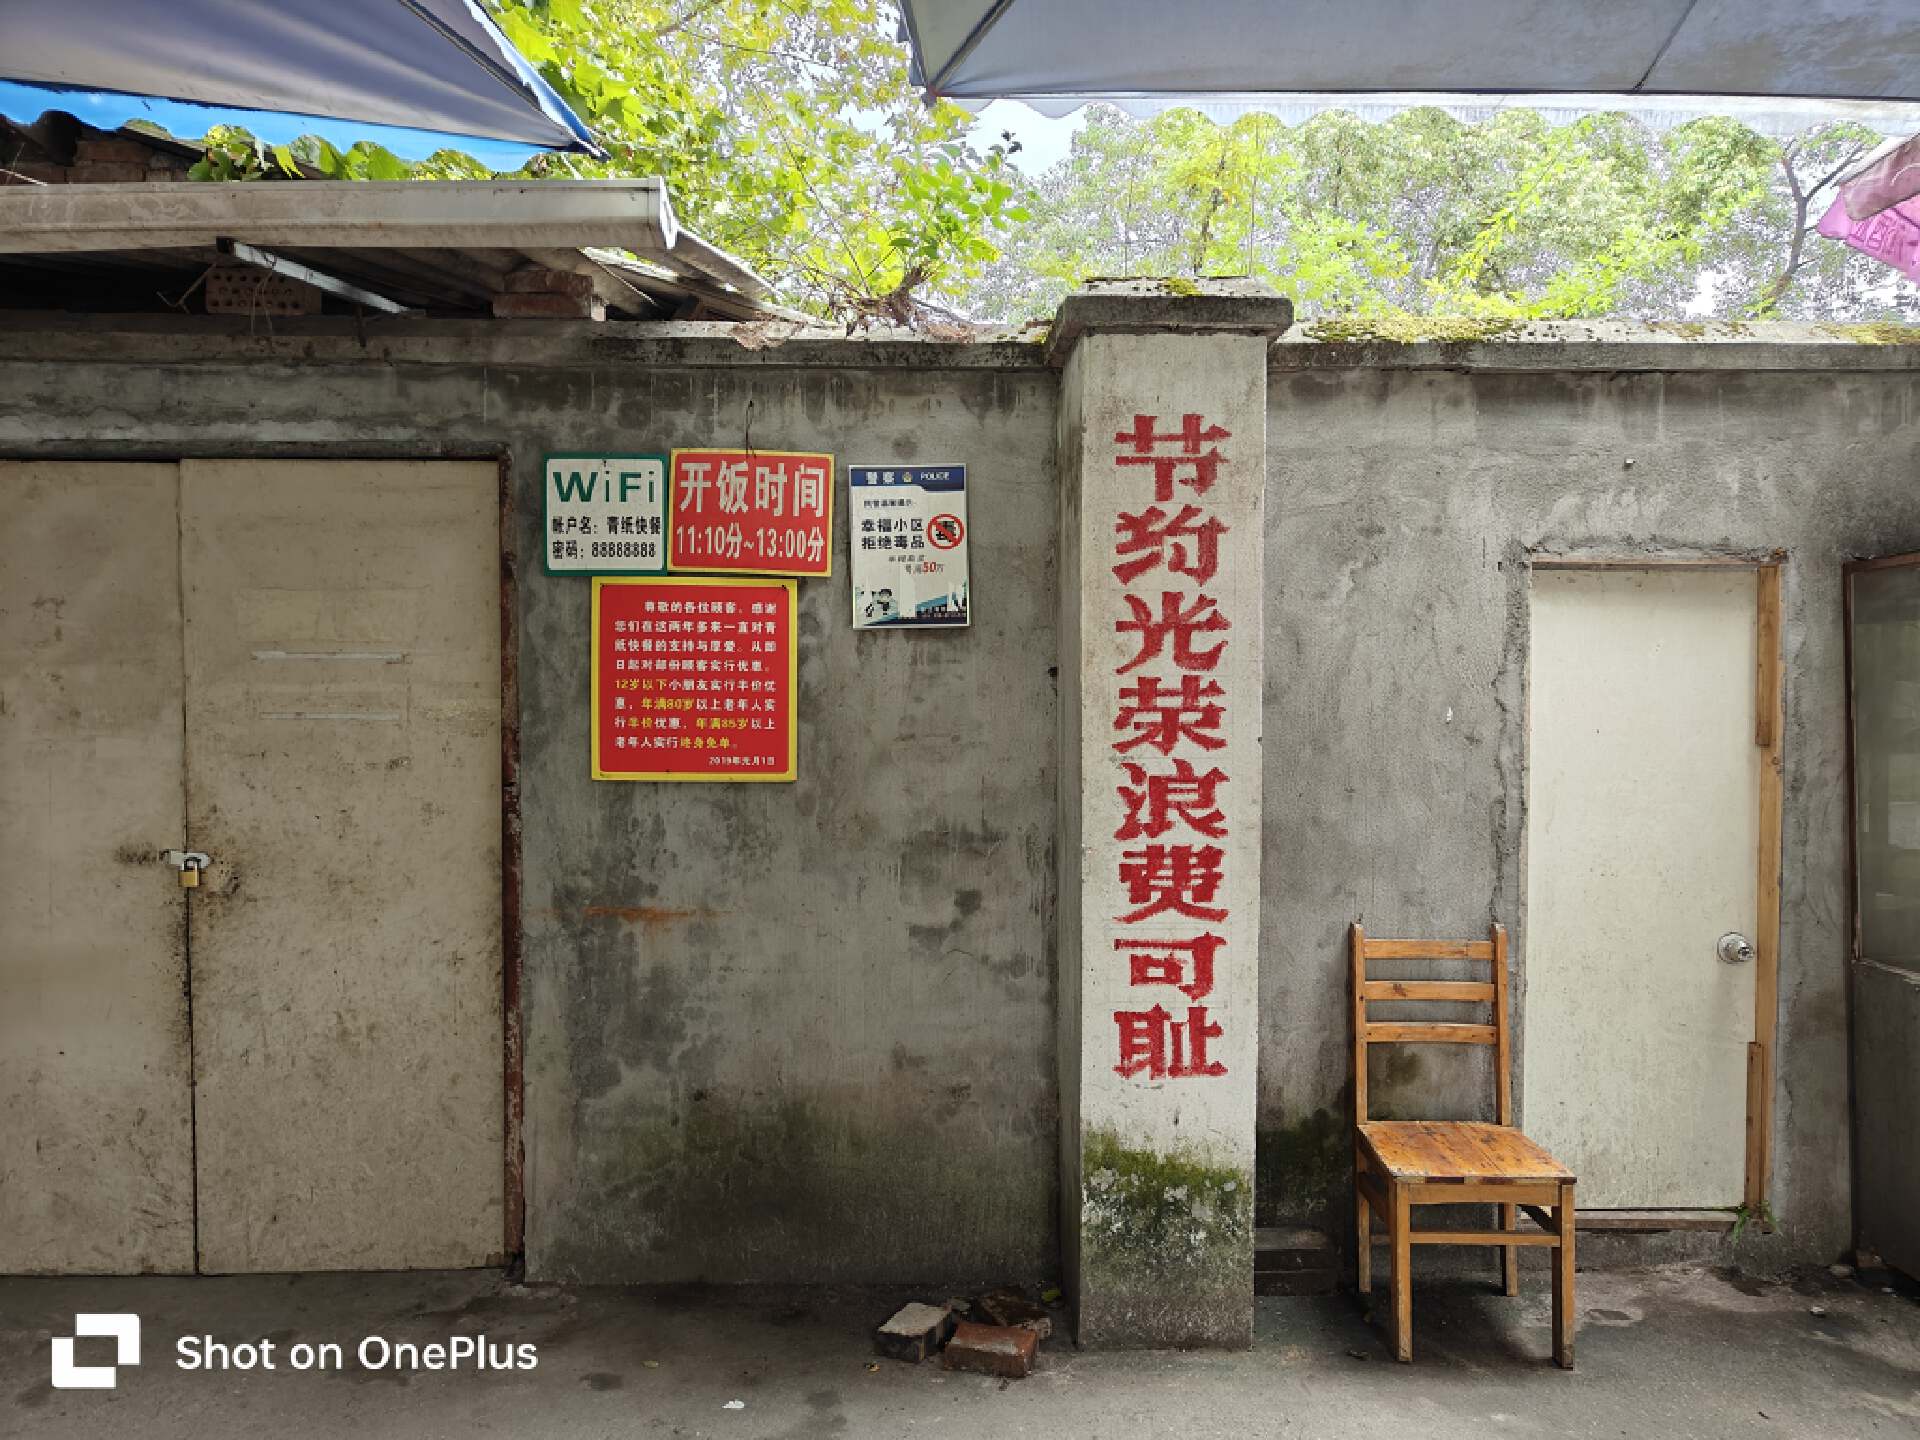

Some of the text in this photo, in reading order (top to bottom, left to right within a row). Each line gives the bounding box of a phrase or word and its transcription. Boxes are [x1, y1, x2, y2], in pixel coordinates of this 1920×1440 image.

[552, 470, 656, 503] WiFi
[920, 471, 950, 481] POLICE
[680, 461, 825, 518] 开饭时间
[861, 516, 924, 533] 幸福小区
[861, 535, 925, 550] 拒绝毒品
[1112, 413, 1233, 1081] 节约光荣浪费可耻
